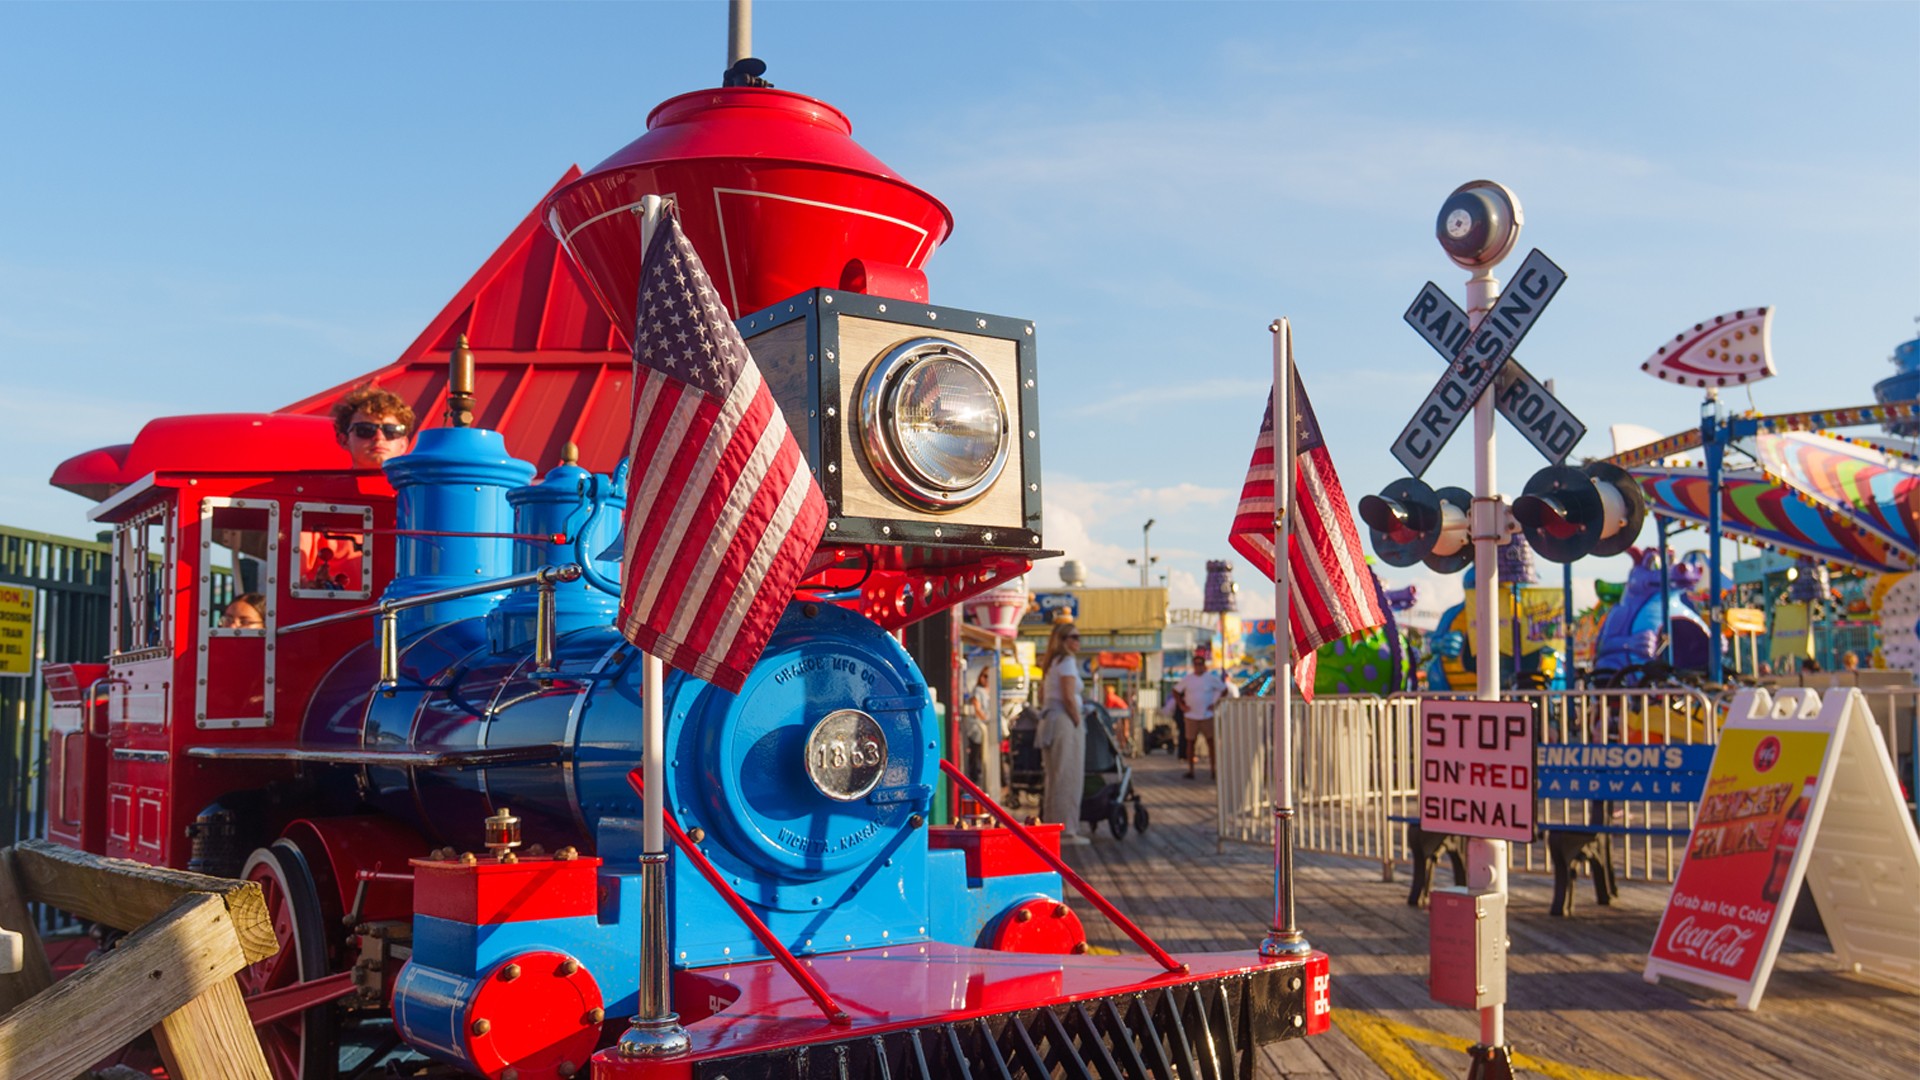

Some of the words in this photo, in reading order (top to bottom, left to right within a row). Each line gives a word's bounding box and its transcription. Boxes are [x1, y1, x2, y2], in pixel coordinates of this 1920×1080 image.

[1405, 268, 1548, 460] CROSSING
[1411, 291, 1471, 358] RAIL
[1501, 378, 1576, 455] ROAD
[1426, 713, 1525, 750] STOP
[815, 742, 880, 768] 1863
[1537, 746, 1683, 768] ENKINSON'S
[1425, 759, 1460, 784] ON
[1470, 763, 1528, 790] RED
[1425, 797, 1528, 830] SIGNAL
[1673, 892, 1700, 910] Grab
[1701, 900, 1717, 914] an
[1718, 901, 1737, 918] Ice
[1738, 905, 1770, 925] Cold
